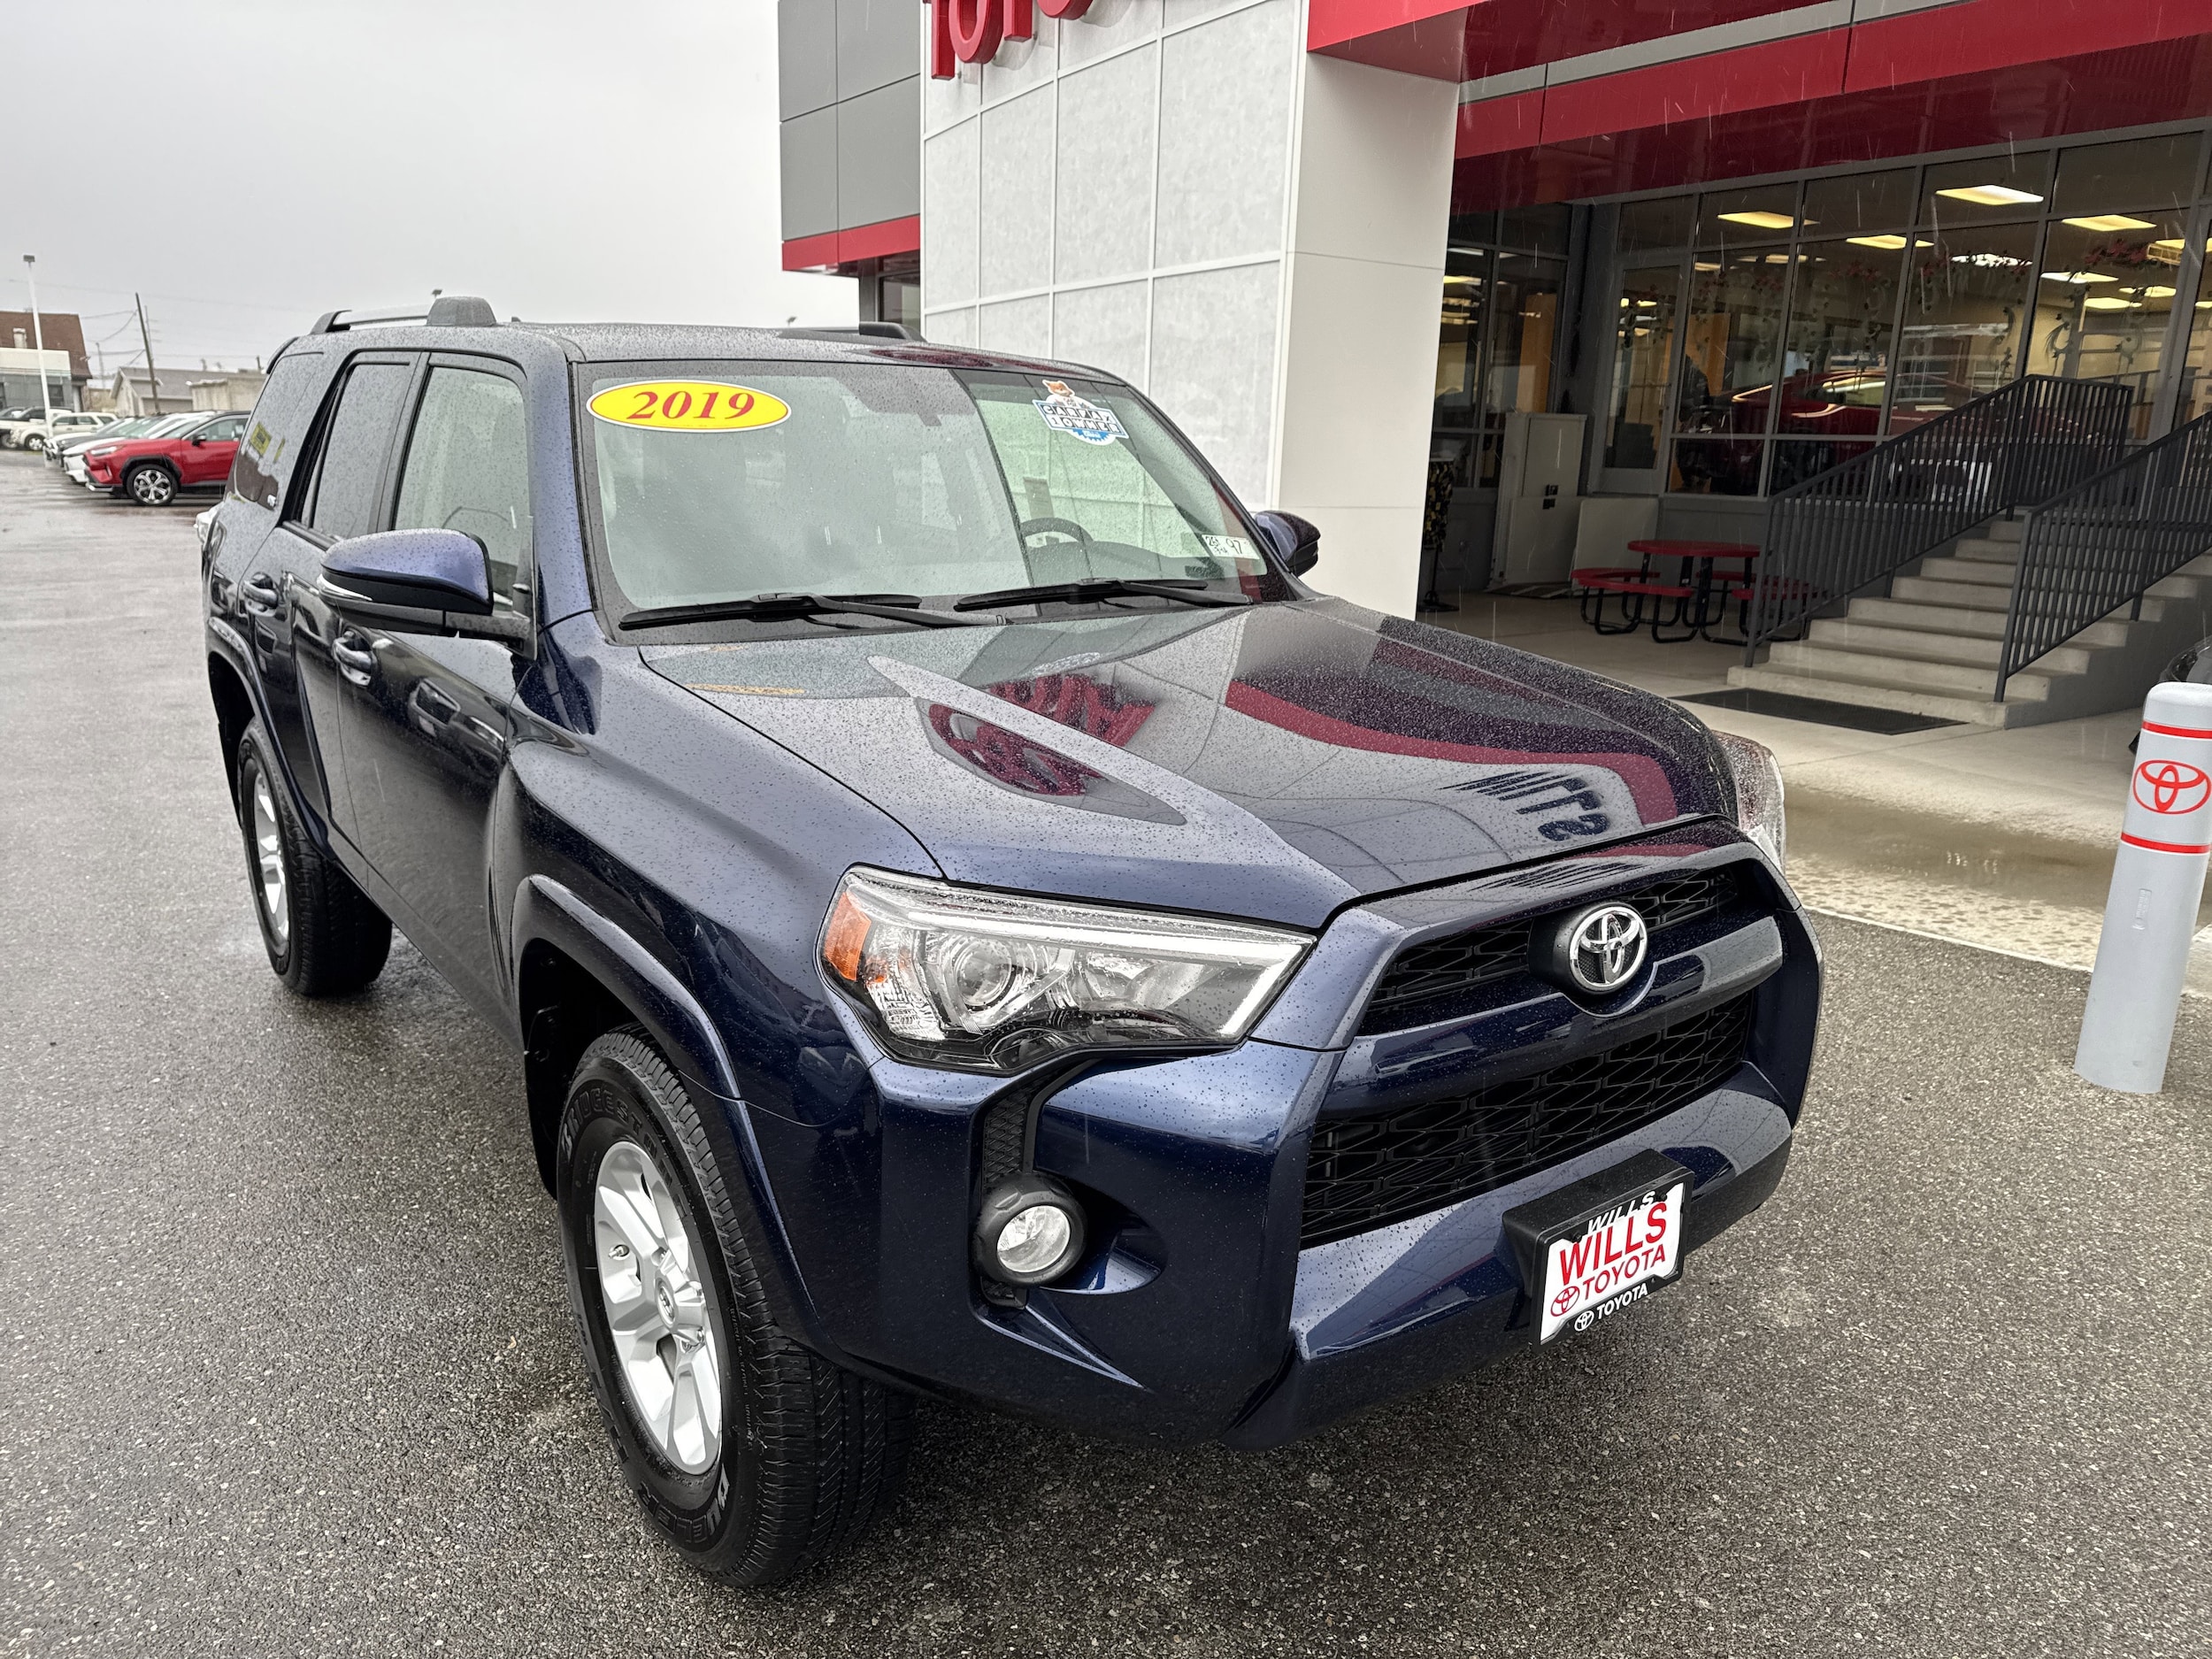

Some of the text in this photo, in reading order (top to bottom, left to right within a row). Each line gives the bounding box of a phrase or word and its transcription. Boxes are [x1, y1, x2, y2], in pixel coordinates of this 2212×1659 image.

[626, 391, 755, 419] 2019
[1042, 405, 1113, 422] CARFAX
[1062, 418, 1120, 433] OWNER
[1587, 1190, 1655, 1235] WILLS
[1560, 1202, 1667, 1286] WILLS
[1583, 1244, 1666, 1301] TOYOTA
[1596, 1283, 1648, 1319] TOYOTA
